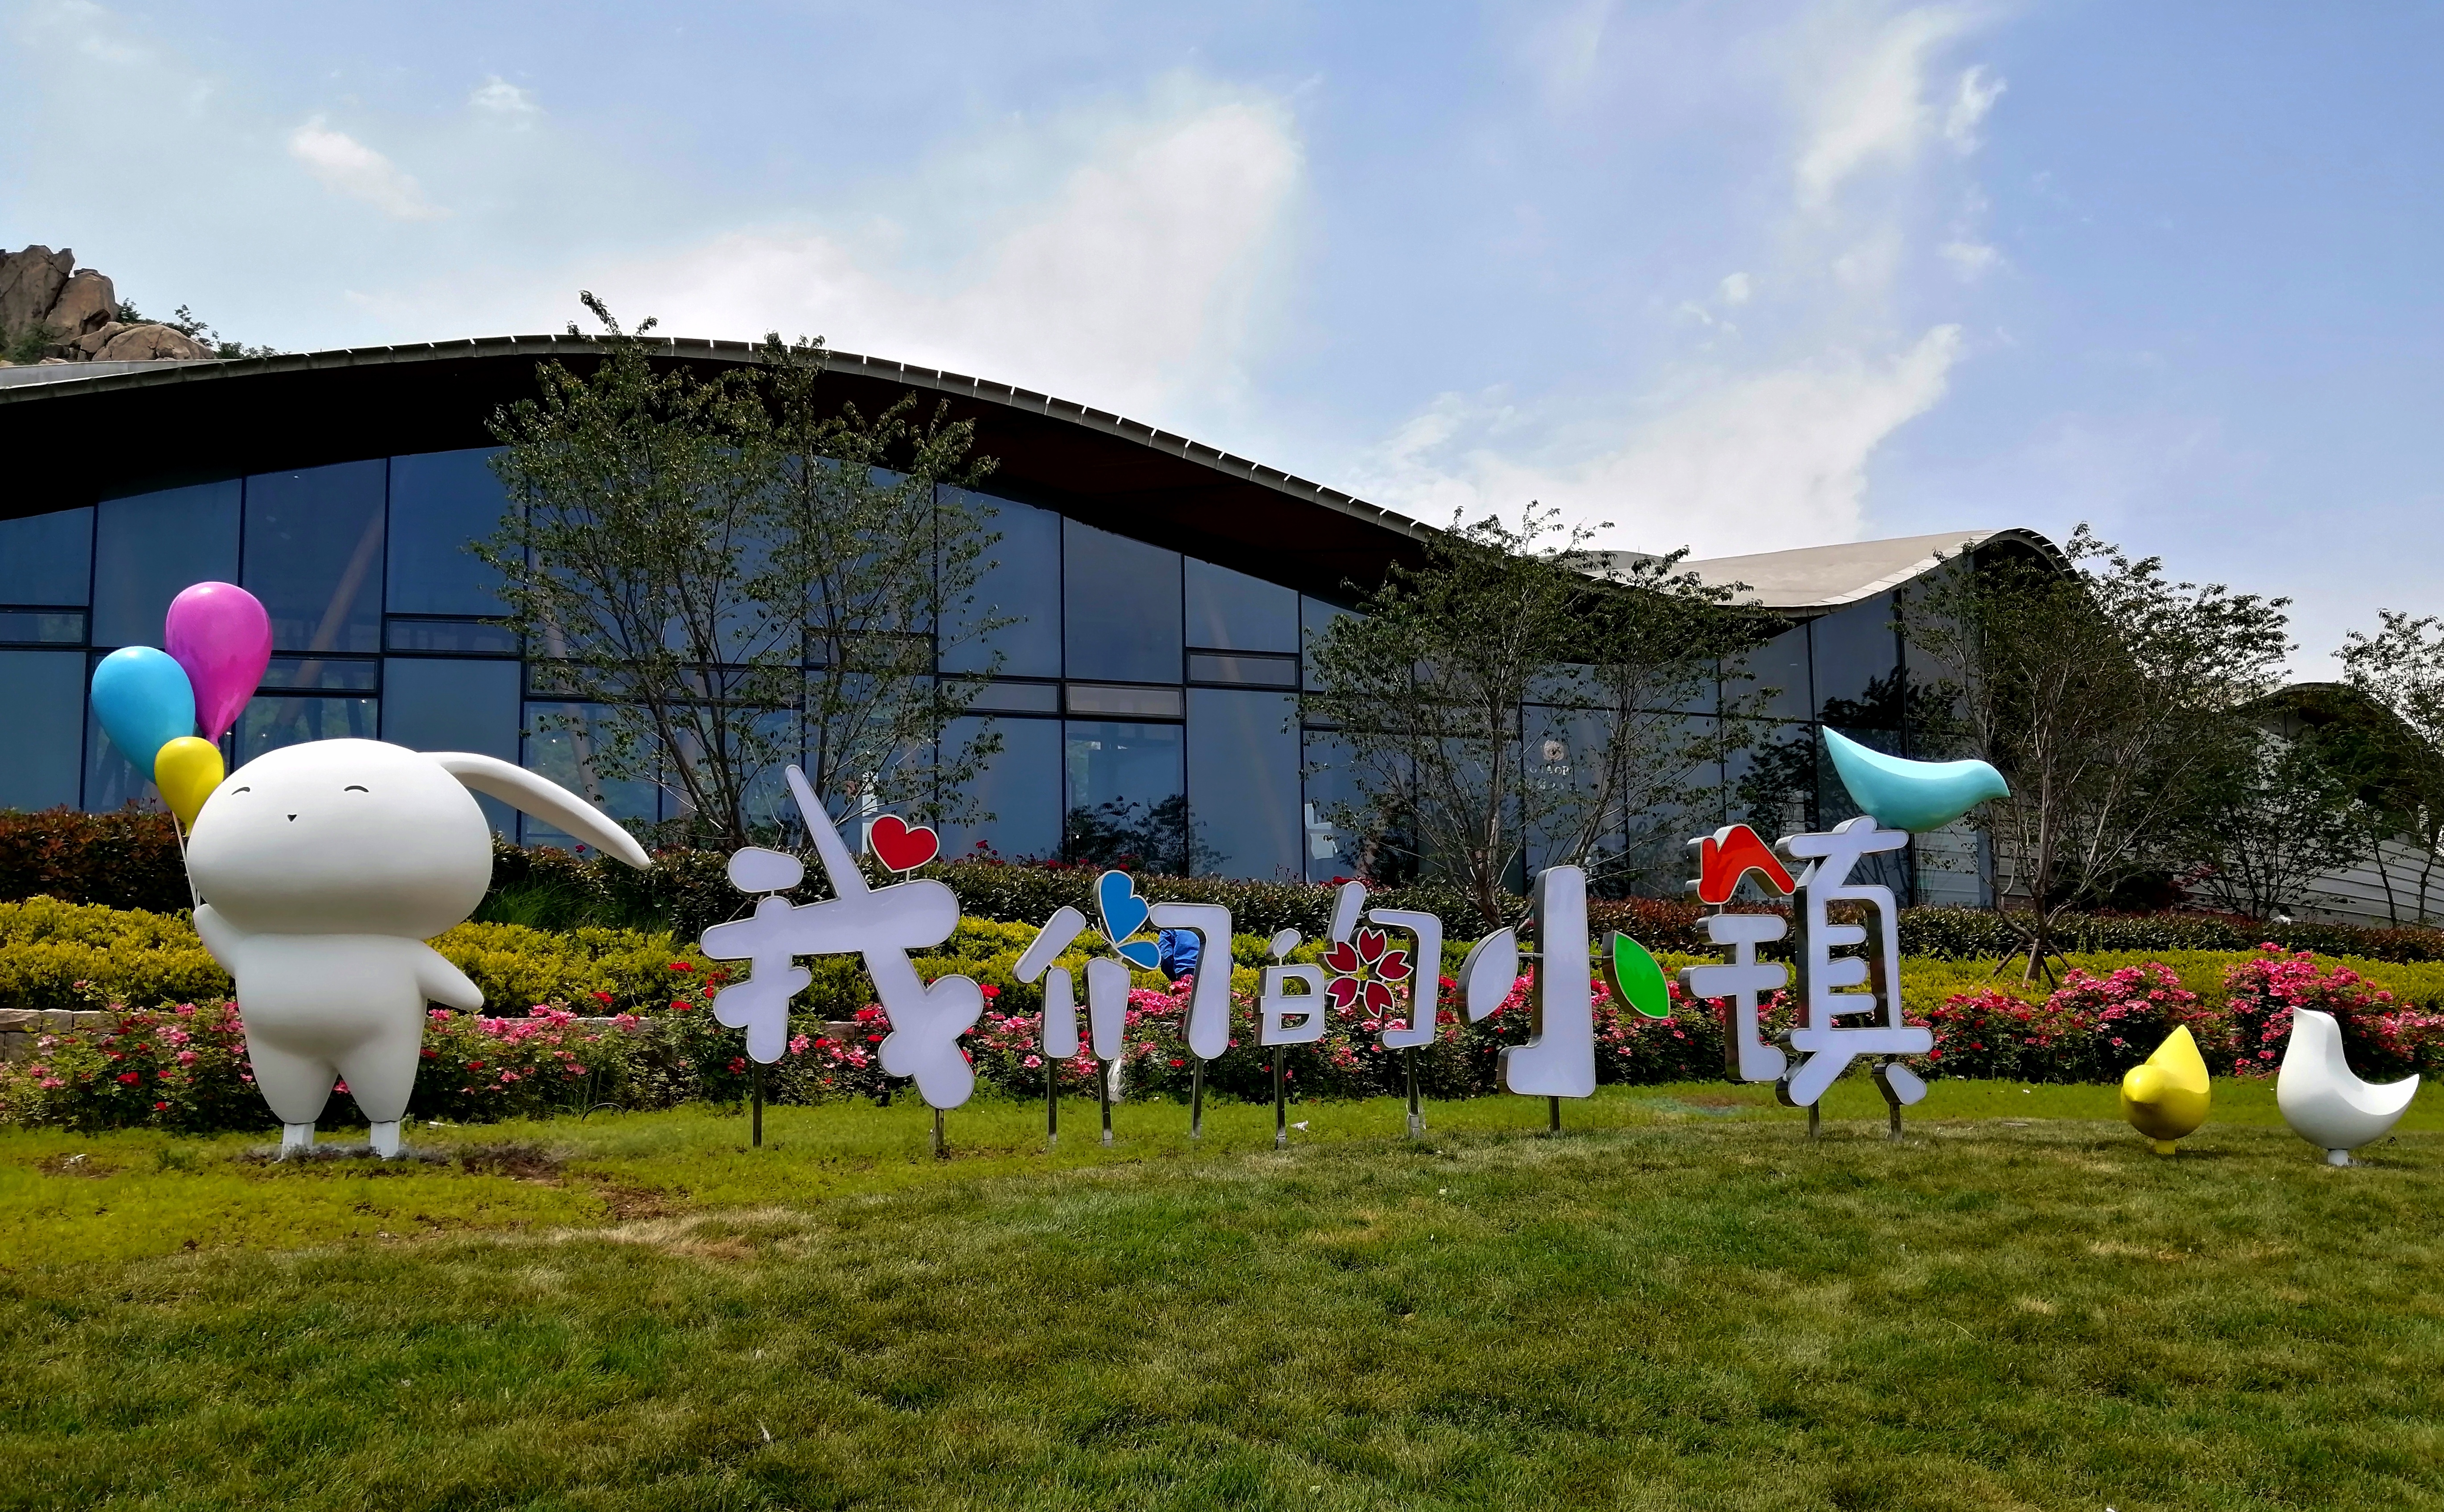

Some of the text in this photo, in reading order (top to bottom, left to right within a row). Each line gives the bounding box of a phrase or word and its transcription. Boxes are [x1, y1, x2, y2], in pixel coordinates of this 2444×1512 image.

[701, 764, 1934, 1109] 我们的小镇
